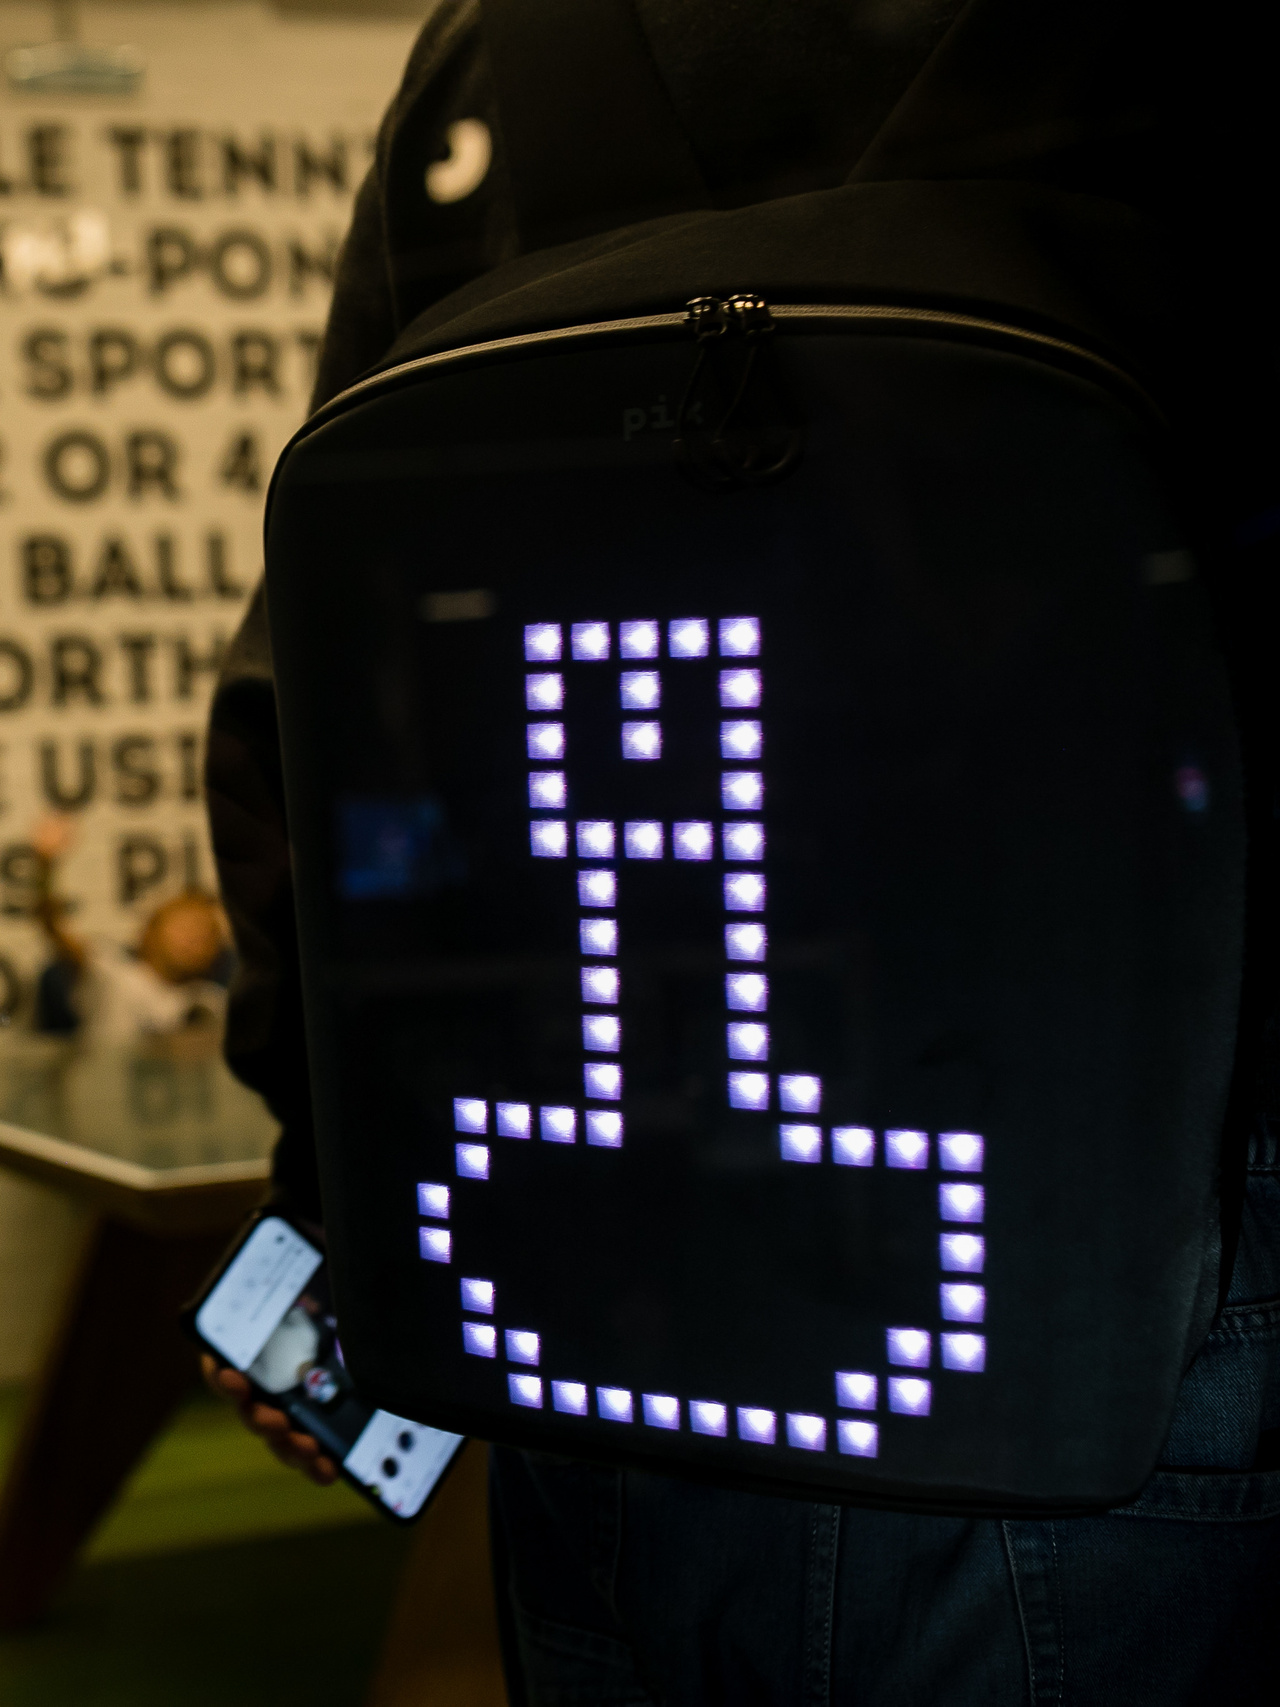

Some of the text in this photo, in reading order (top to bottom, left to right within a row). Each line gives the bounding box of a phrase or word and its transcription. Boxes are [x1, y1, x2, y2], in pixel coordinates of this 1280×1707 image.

[108, 122, 375, 200] TENN
[45, 430, 182, 503] OR
[220, 430, 264, 496] 4
[23, 533, 248, 607] BALL
